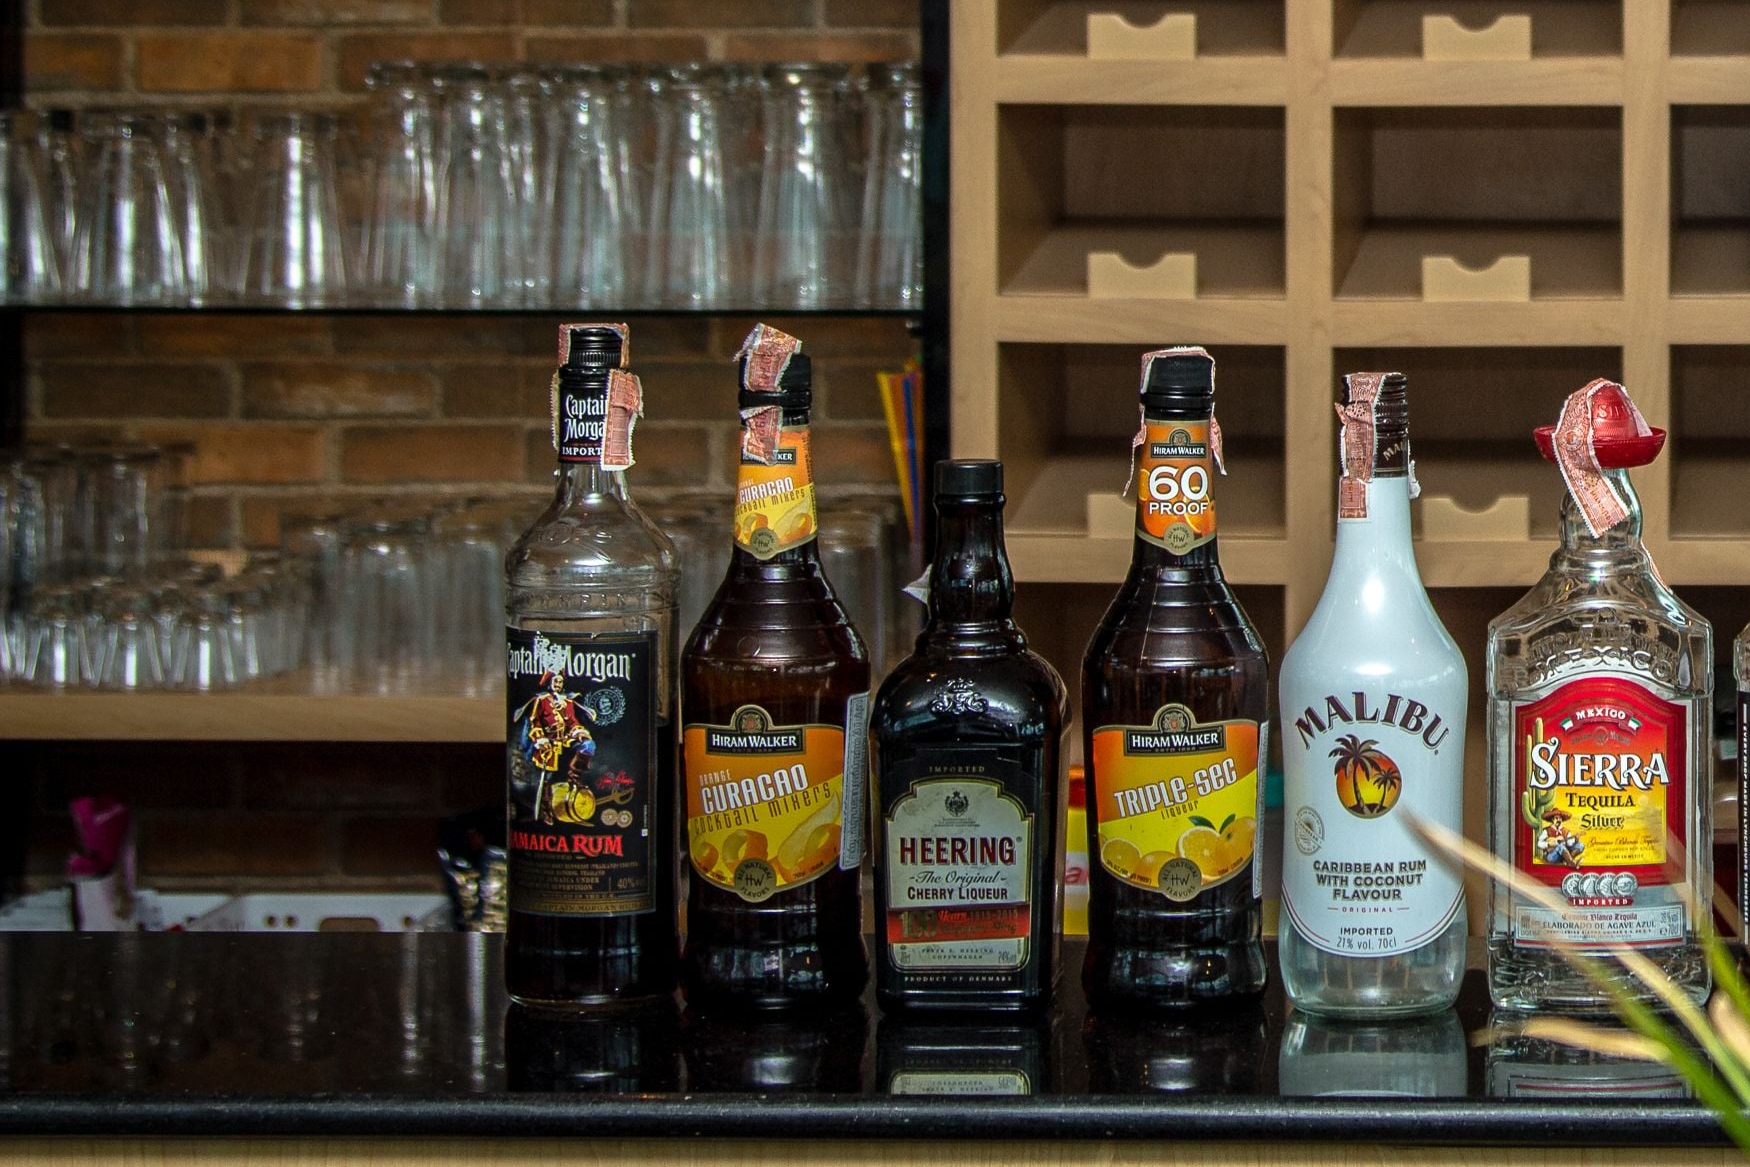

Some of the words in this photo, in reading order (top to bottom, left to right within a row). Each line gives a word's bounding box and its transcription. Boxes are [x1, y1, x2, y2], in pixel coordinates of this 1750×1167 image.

[566, 394, 608, 419] Captai
[564, 418, 605, 442] Morga
[562, 447, 602, 456] IMPORT
[1153, 446, 1178, 456] HIRAM
[1178, 446, 1205, 455] WALKER
[740, 477, 794, 504] CURACAO
[1149, 465, 1208, 501] 60
[1149, 502, 1209, 515] PROOF
[1294, 691, 1450, 751] MALIBU
[712, 734, 747, 747] HIRAM
[748, 734, 797, 747] WALKER
[1132, 735, 1171, 748] HIRAM
[1172, 733, 1219, 746] WALKER
[1530, 737, 1670, 791] SIERRA
[701, 763, 809, 815] CURACAO
[1566, 792, 1636, 811] TEQUILA
[572, 835, 624, 857] RUM
[900, 837, 1016, 865] HEERING
[1313, 860, 1394, 873] CARIBBEAN
[1399, 860, 1427, 871] RUM
[914, 870, 942, 884] The
[945, 870, 1001, 888] Original
[1316, 873, 1349, 886] WITH
[1353, 873, 1423, 887] COCONUT
[908, 886, 954, 900] CHERRY
[958, 886, 1008, 900] LIQUEUR
[1333, 888, 1402, 901] FLAVOUR
[1340, 927, 1394, 935] IMPORTED
[1337, 937, 1354, 949] 21%
[1358, 939, 1374, 950] vol.
[1378, 937, 1397, 949] 70cl
